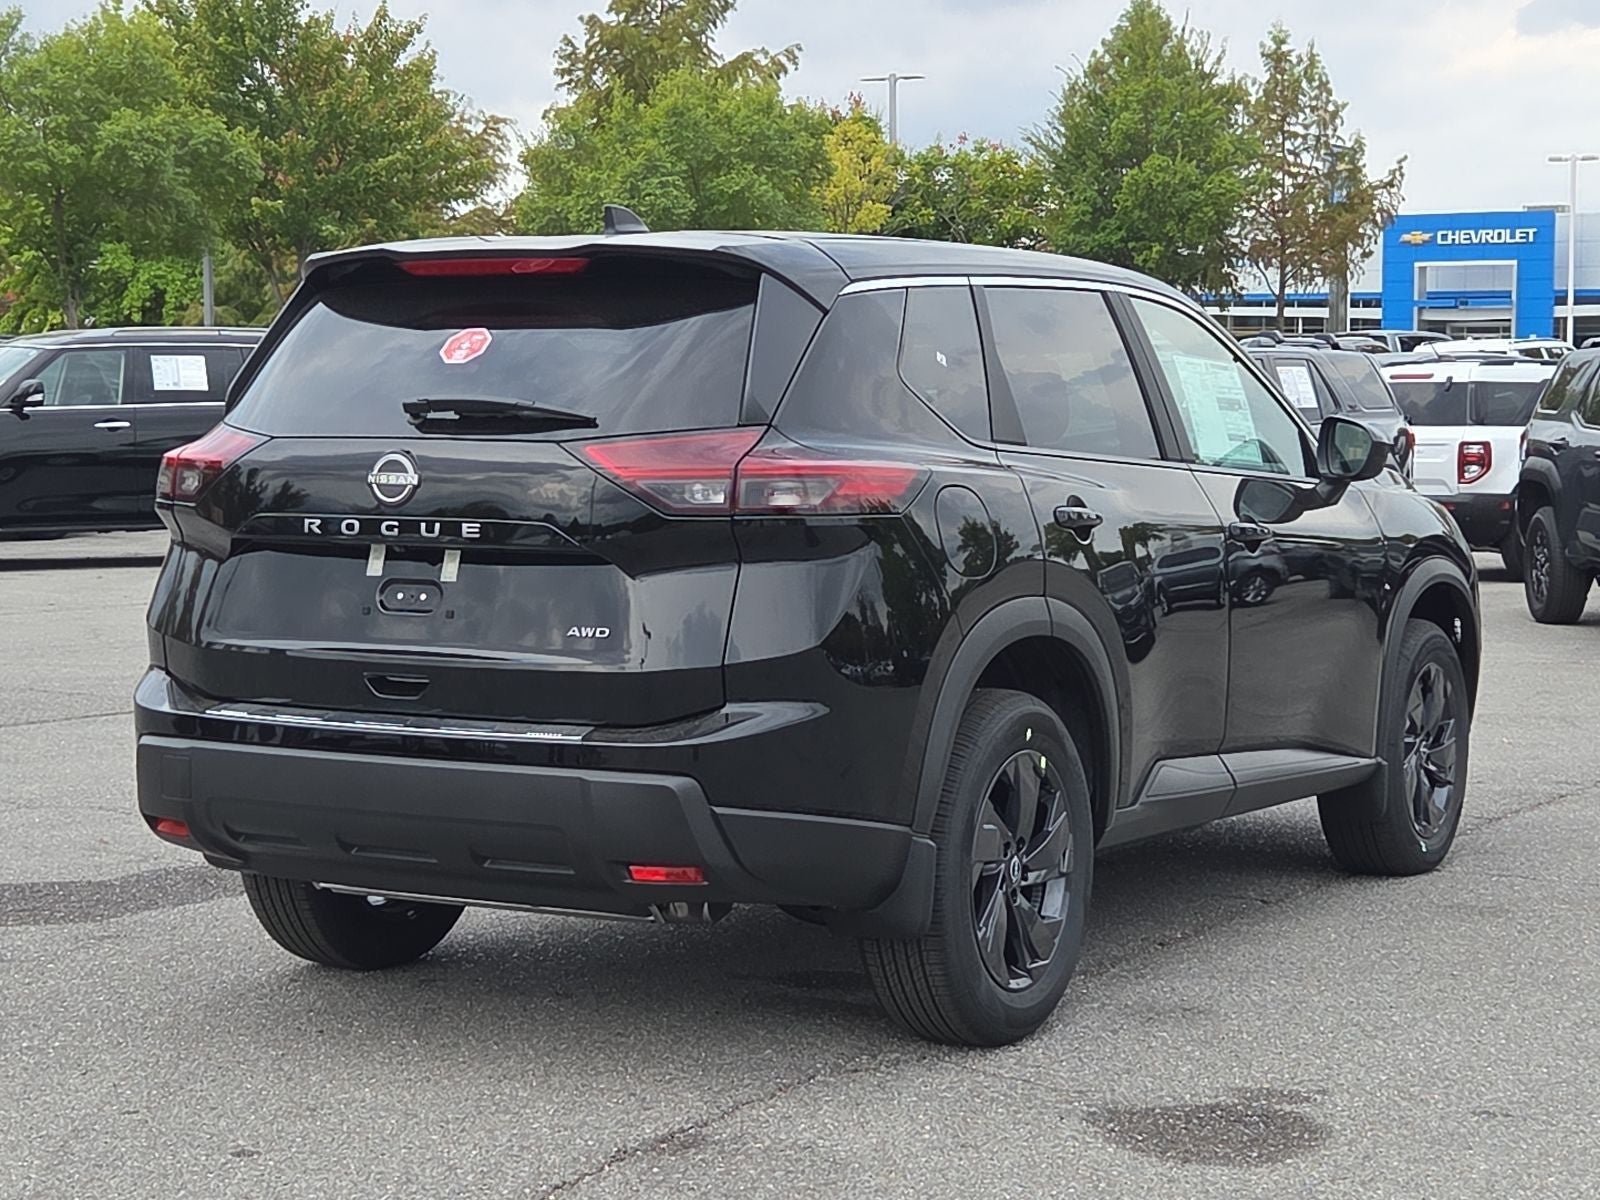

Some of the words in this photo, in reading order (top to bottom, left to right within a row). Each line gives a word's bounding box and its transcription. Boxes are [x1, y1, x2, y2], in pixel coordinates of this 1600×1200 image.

[1437, 228, 1538, 245] CHEVROLET
[367, 474, 419, 486] NISSAN
[303, 517, 482, 538] ROGUE
[566, 626, 611, 638] AWD
